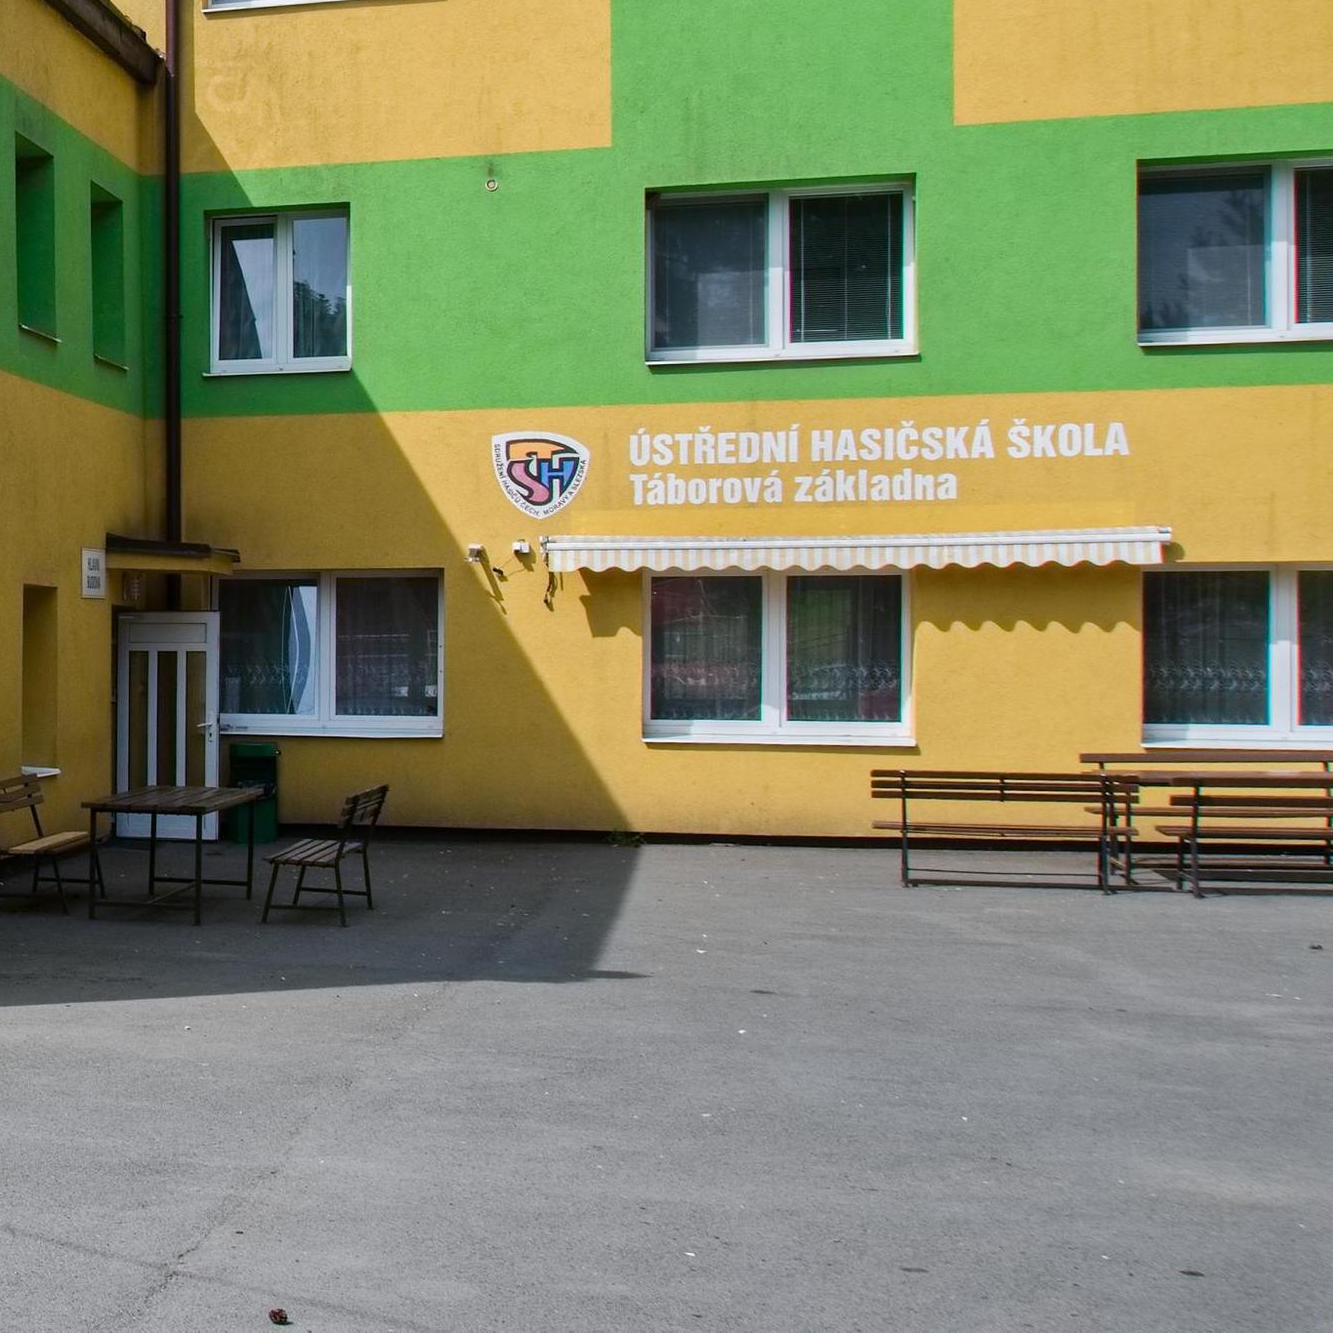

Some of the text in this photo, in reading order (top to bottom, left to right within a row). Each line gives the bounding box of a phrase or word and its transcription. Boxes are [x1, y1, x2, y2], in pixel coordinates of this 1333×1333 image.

[630, 418, 1130, 466] ÚSTŘEDNÍ HASIČSKÁ ŠKOLA
[629, 468, 958, 506] Táborová základna
